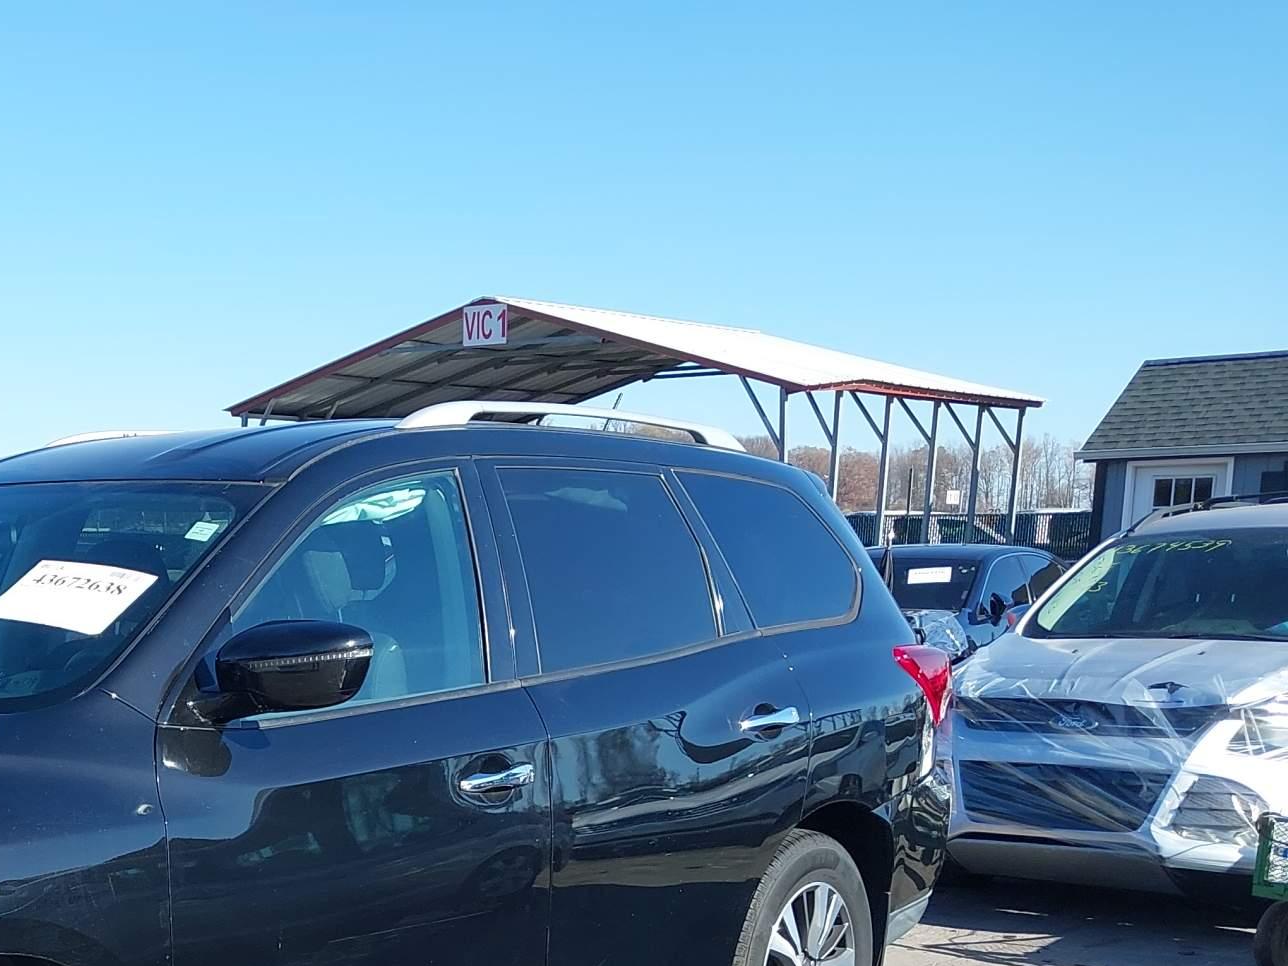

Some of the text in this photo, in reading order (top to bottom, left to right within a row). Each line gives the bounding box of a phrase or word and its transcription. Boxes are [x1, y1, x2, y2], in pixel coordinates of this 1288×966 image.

[465, 309, 506, 340] VIC 1
[33, 573, 127, 595] 43672638
